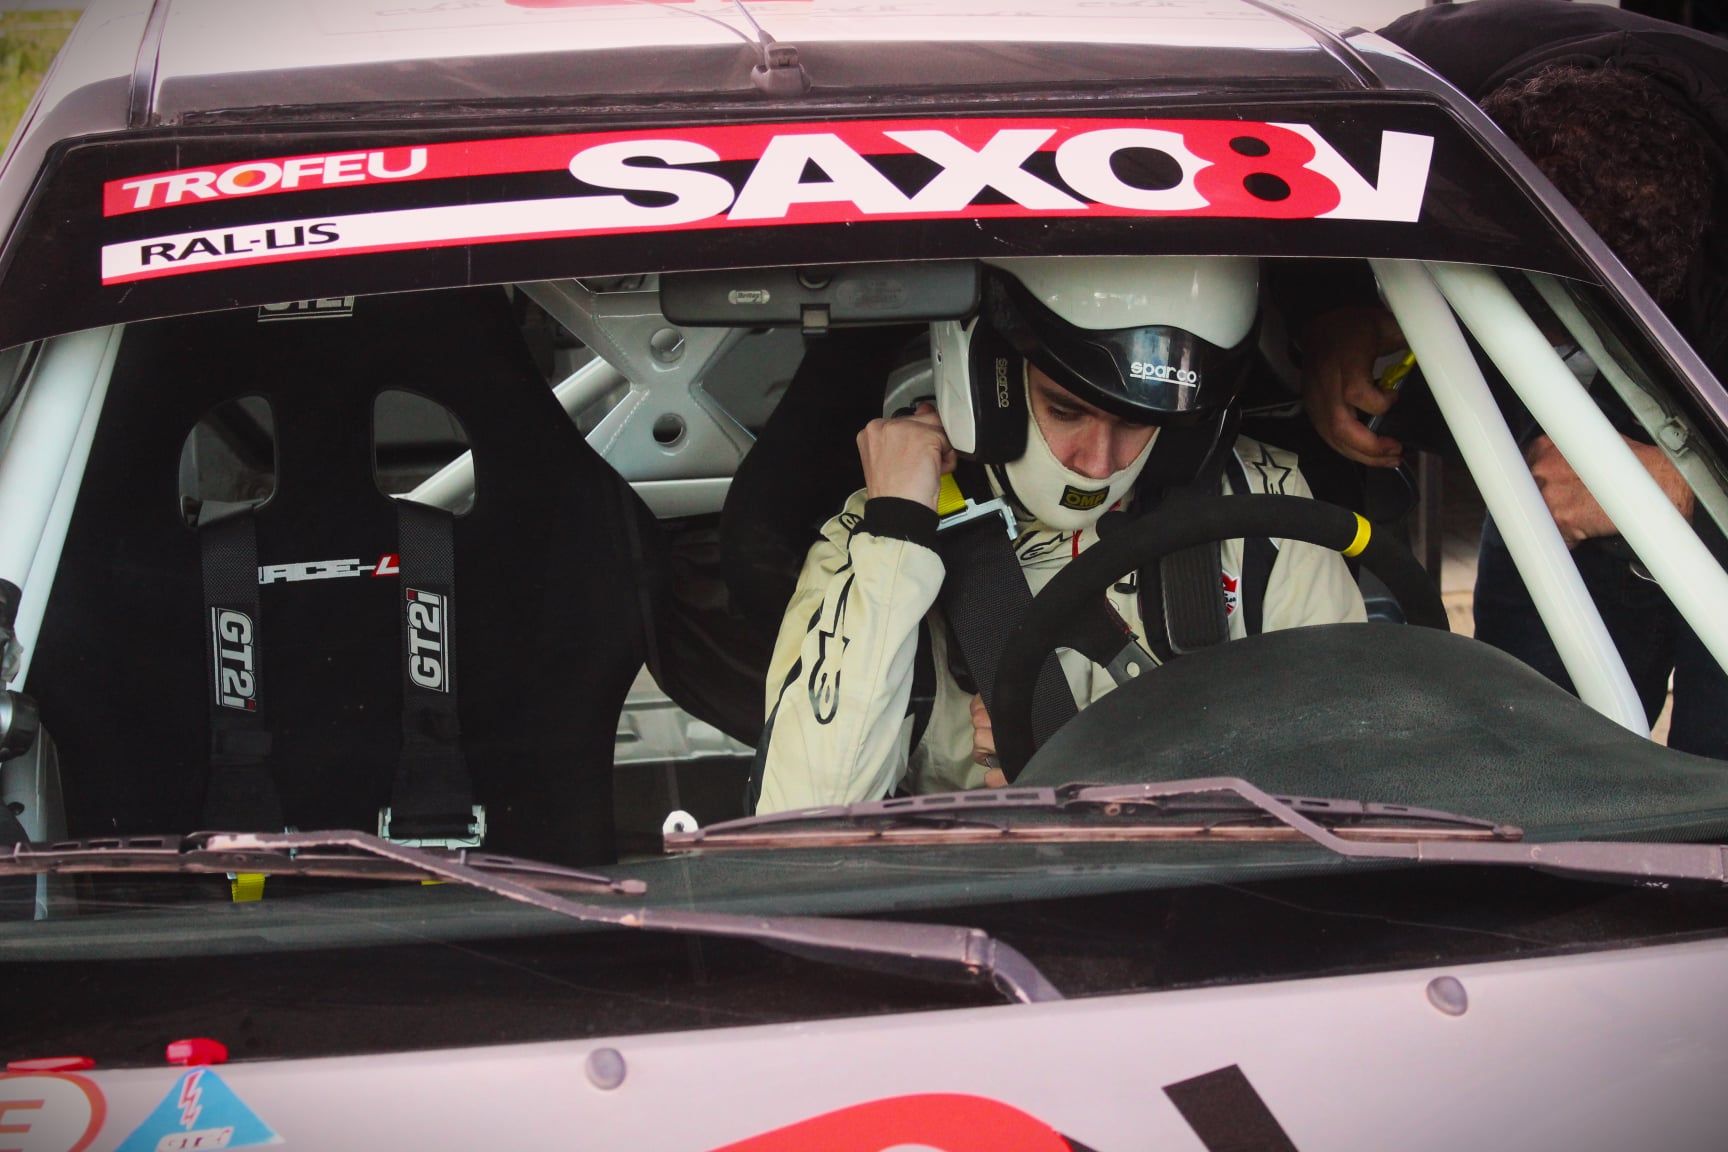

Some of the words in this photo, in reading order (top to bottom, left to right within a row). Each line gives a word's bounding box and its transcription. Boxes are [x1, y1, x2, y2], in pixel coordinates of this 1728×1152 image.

[122, 148, 428, 210] TROFEU
[998, 358, 1010, 408] sparco
[1130, 361, 1197, 386] sparco
[258, 557, 400, 584] ACE-L
